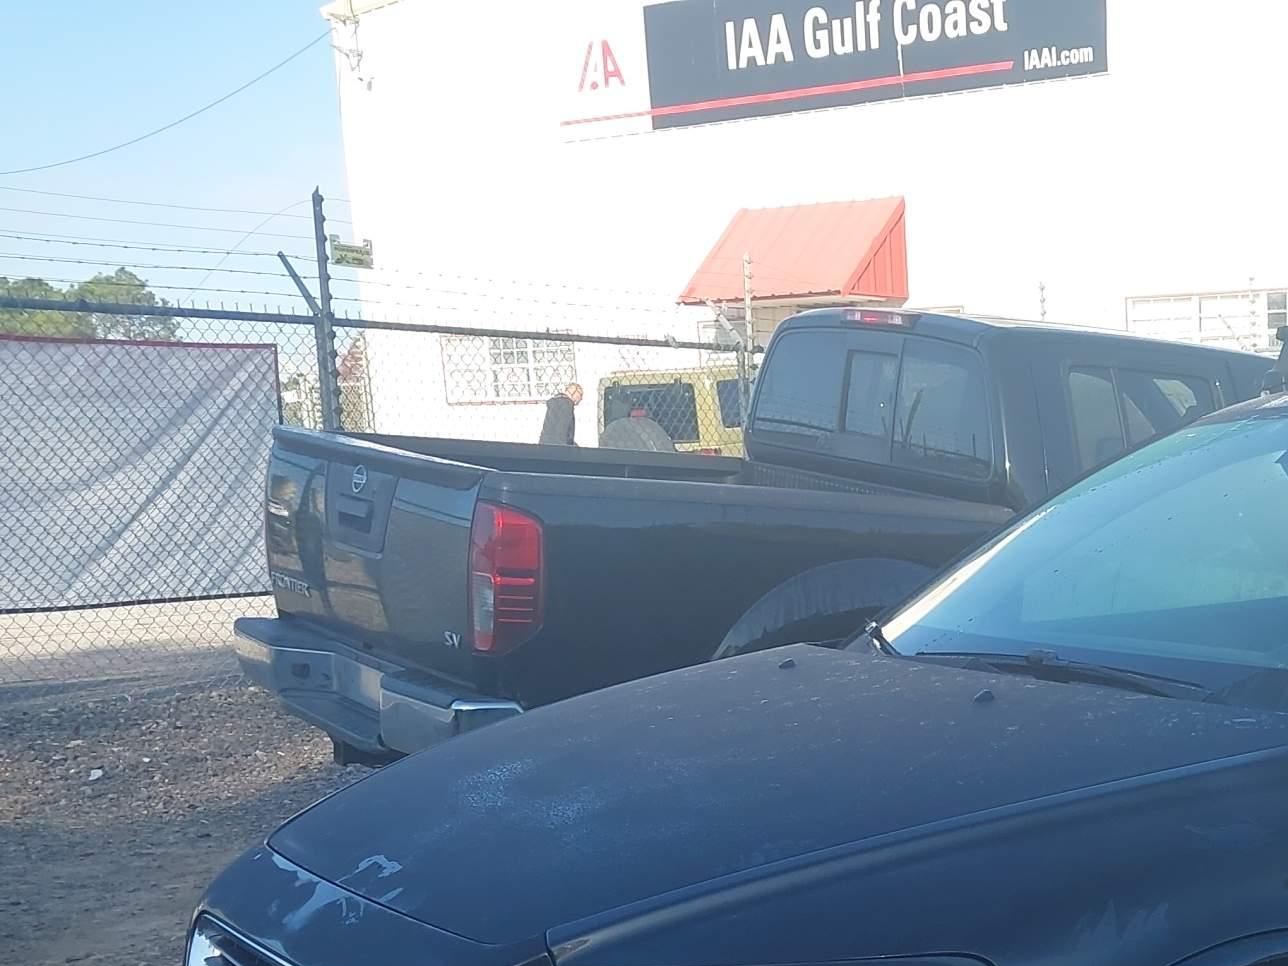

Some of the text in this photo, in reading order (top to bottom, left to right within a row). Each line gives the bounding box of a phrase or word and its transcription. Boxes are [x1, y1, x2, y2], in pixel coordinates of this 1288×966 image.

[725, 0, 1008, 70] IAA Gulf Coast
[1023, 46, 1094, 70] IAAI.com
[444, 631, 461, 648] SV
